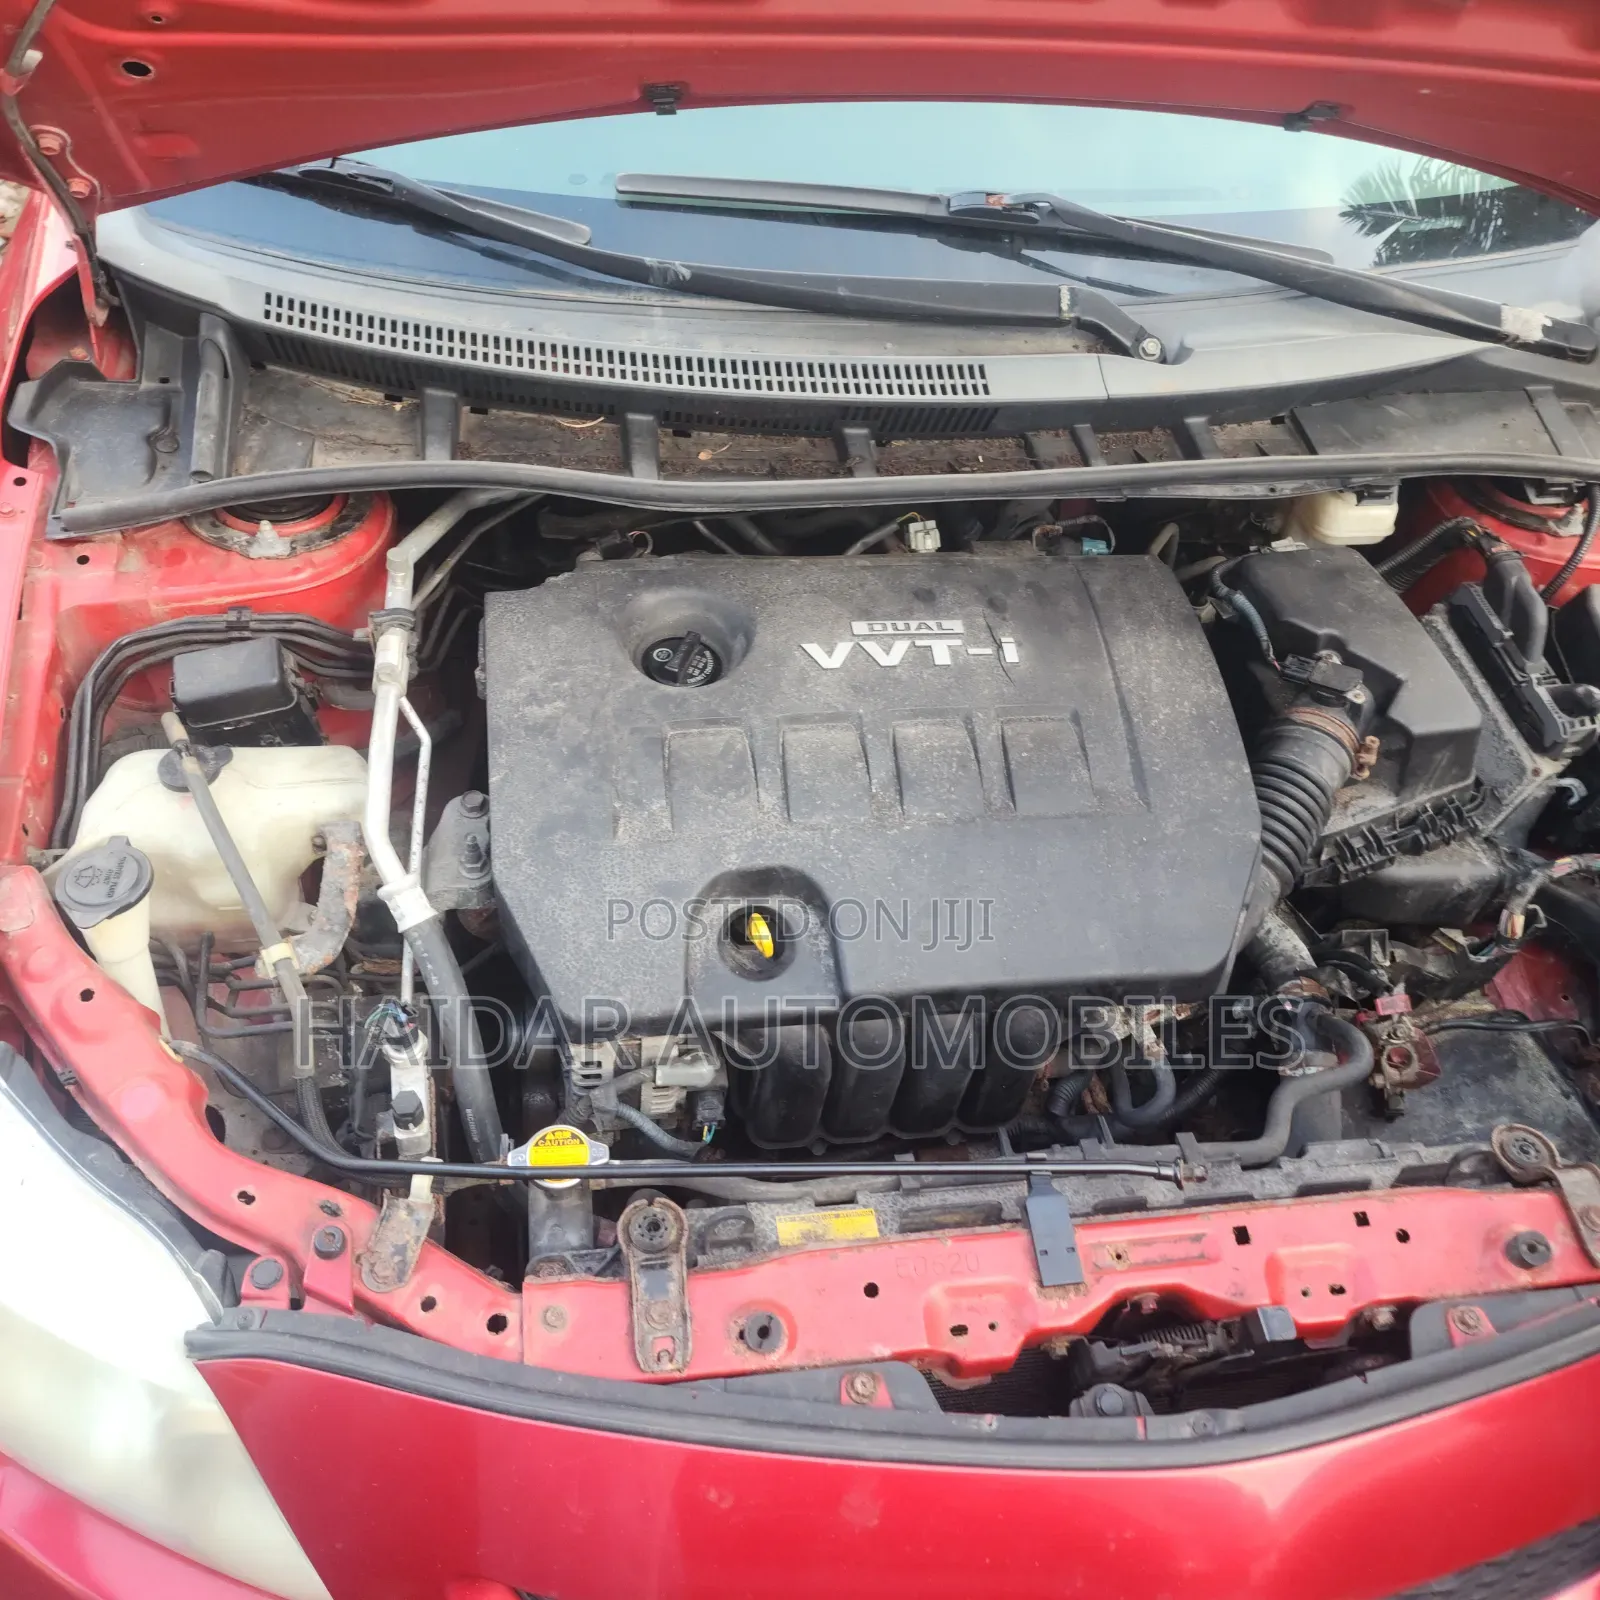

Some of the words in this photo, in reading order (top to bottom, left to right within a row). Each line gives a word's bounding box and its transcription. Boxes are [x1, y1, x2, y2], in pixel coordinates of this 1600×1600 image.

[866, 621, 955, 633] DUAL
[799, 637, 1020, 670] VVT-i
[537, 1138, 581, 1147] CAUTION
